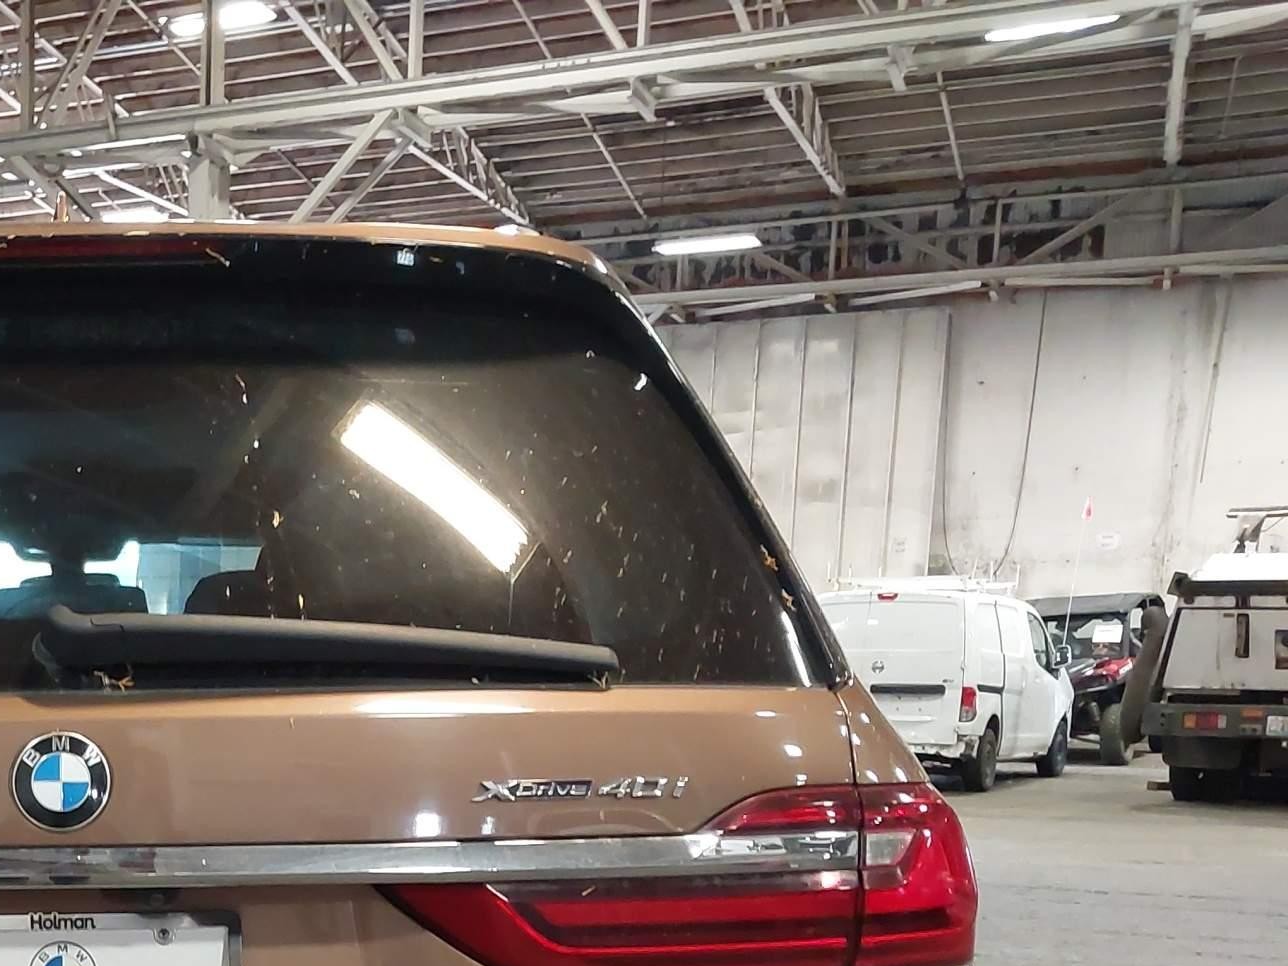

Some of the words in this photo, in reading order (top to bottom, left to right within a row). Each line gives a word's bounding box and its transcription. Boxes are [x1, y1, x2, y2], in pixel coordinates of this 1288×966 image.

[22, 736, 102, 767] BMW
[29, 913, 96, 931] Holman
[38, 943, 88, 963] BMW
